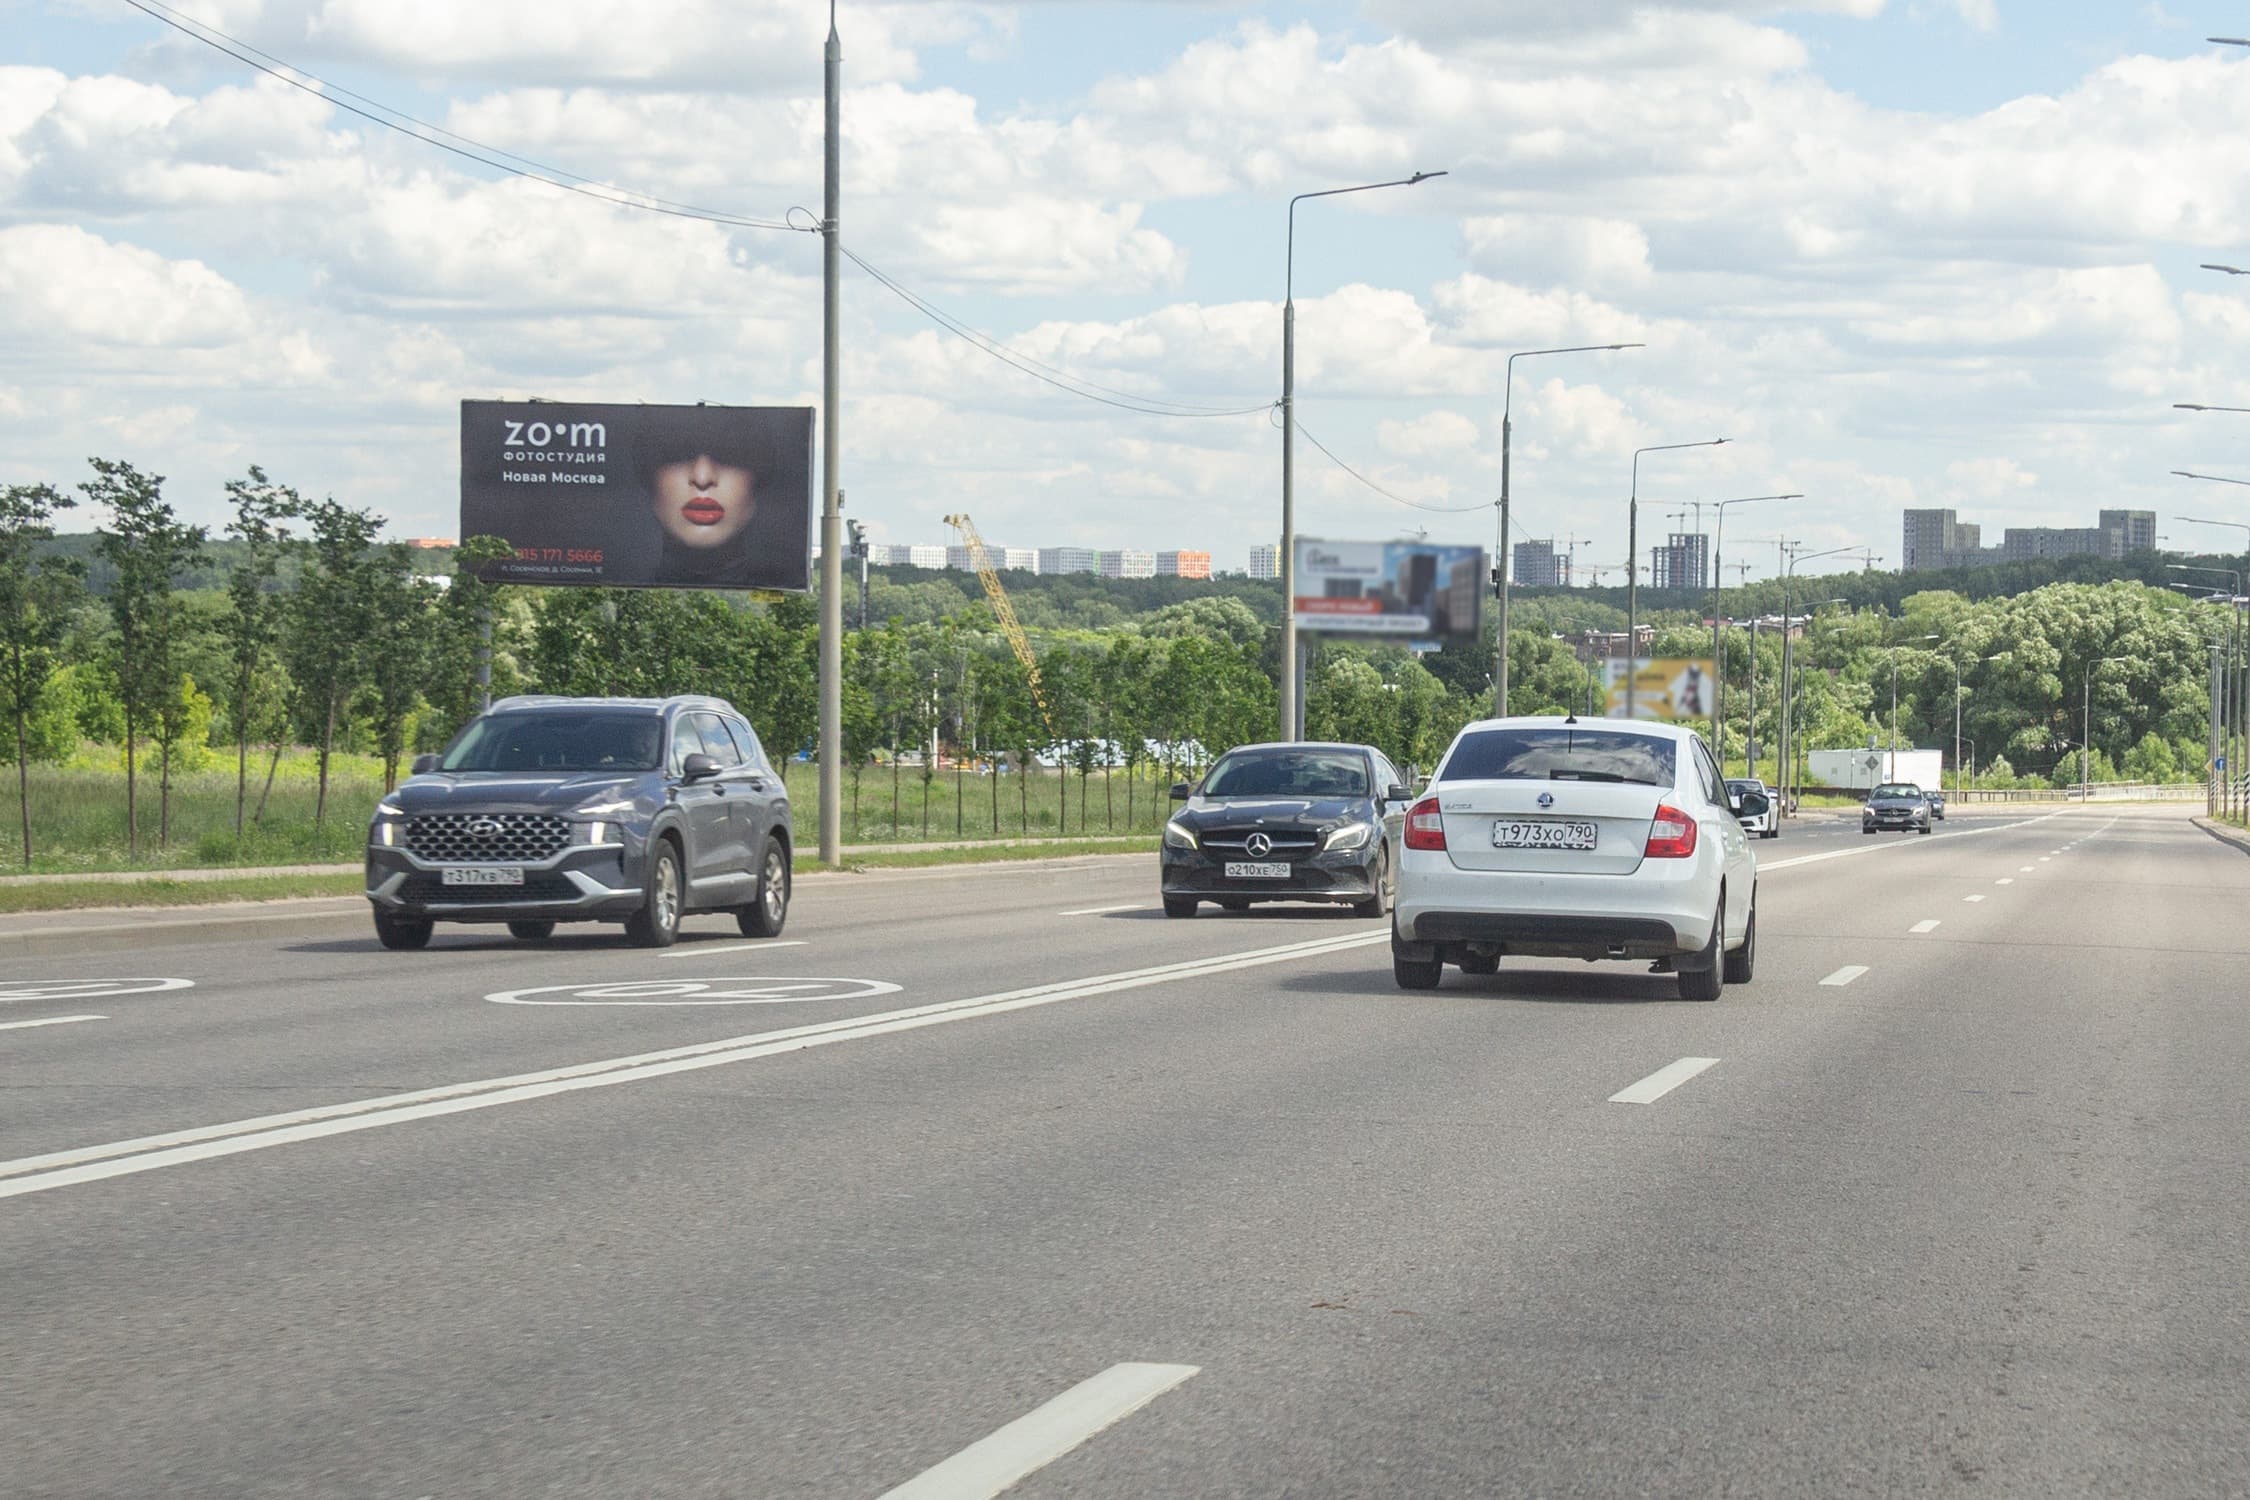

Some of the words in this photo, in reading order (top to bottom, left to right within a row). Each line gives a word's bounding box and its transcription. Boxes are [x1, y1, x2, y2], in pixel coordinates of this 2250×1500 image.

[503, 451, 606, 463] ФОТОСТУДИЯ
[503, 471, 546, 482] Новая
[551, 471, 606, 484] Москва
[1567, 825, 1592, 838] 790
